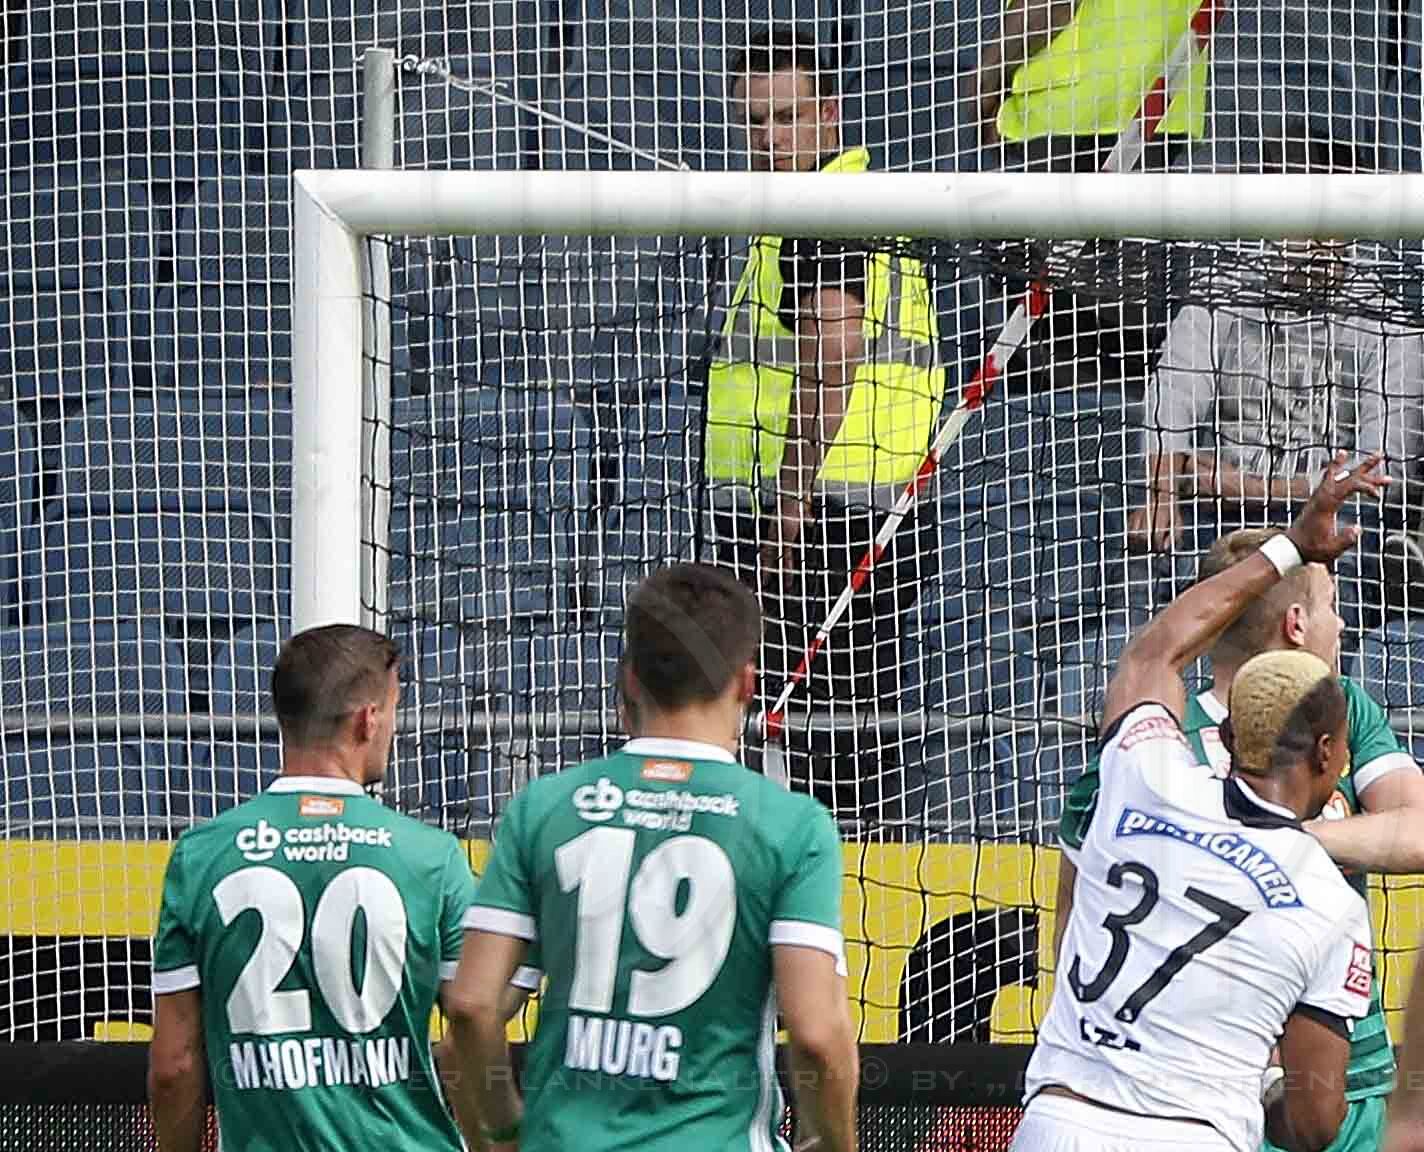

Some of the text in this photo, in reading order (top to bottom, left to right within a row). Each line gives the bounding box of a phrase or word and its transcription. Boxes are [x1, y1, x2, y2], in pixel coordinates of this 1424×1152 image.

[283, 843, 349, 862] world
[285, 824, 392, 849] cashback
[212, 866, 409, 1035] 20
[553, 826, 737, 1019] 19
[1067, 860, 1251, 1024] 37
[564, 1015, 683, 1082] MURG
